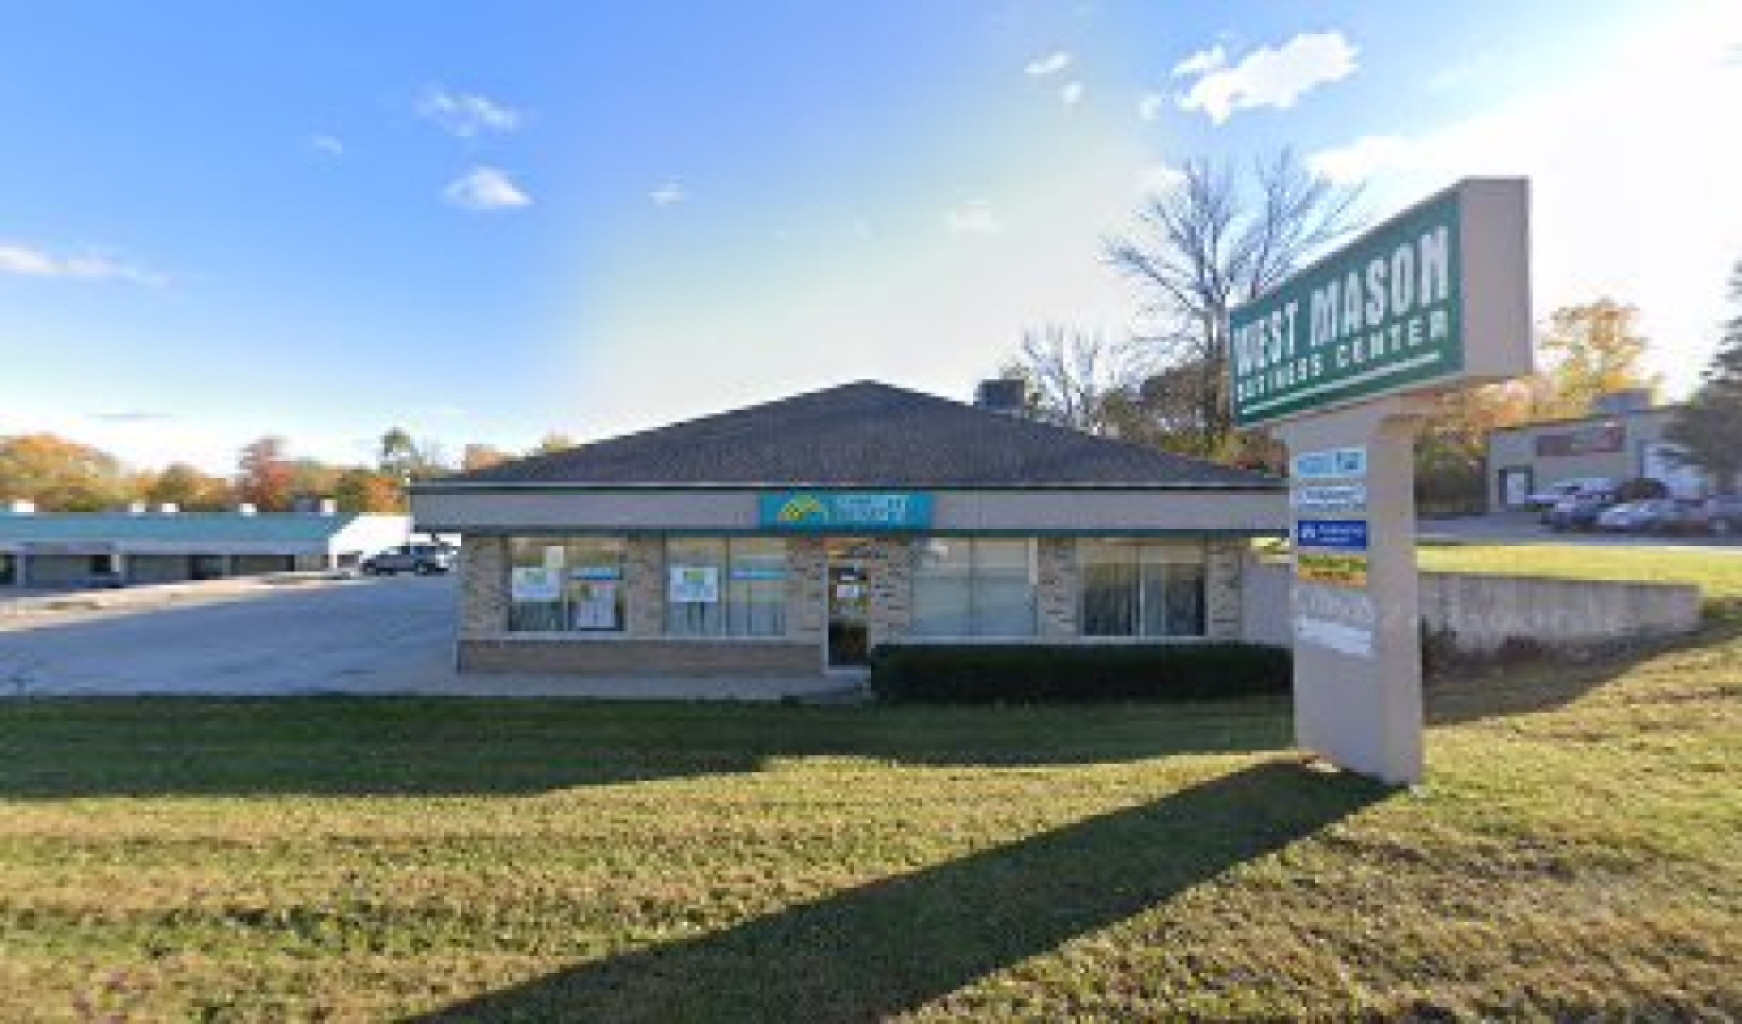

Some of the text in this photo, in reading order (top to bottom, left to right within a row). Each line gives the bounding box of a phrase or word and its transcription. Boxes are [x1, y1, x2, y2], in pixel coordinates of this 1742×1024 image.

[1233, 226, 1449, 377] WEST MASON
[1236, 307, 1449, 402] BUSINESS CENTER
